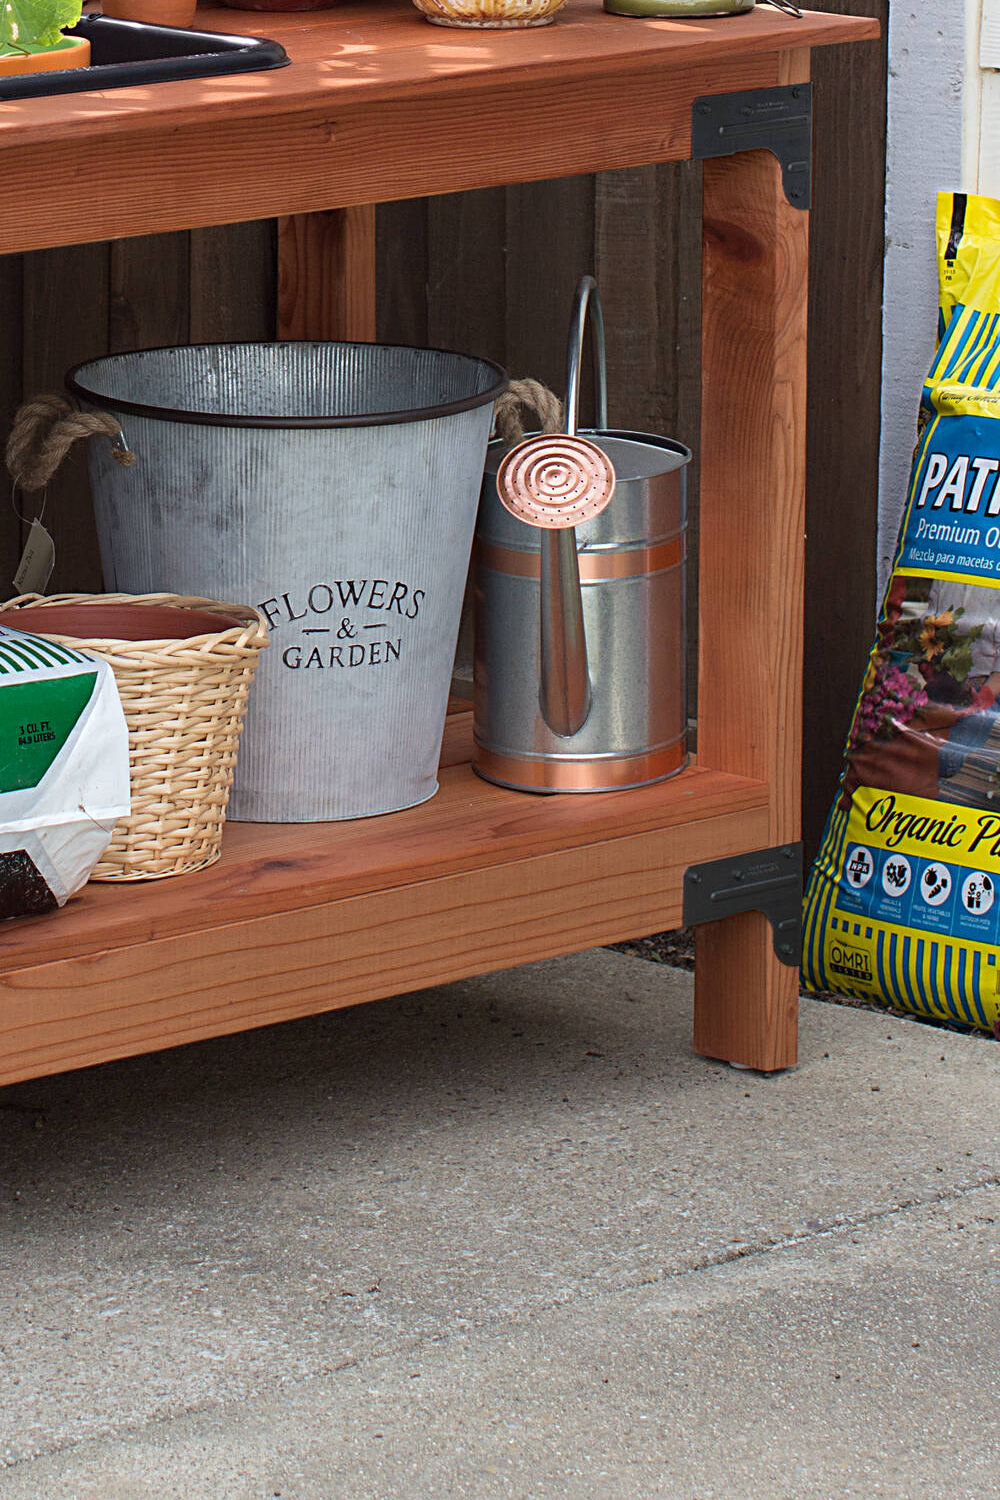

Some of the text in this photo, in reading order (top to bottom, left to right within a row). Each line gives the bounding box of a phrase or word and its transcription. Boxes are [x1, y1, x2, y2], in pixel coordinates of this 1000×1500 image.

[915, 518, 981, 546] Premium
[908, 547, 935, 562] Mezcla
[936, 552, 955, 567] para
[957, 555, 994, 571] macetas
[257, 580, 426, 631] FLOWERS
[336, 617, 358, 639] &
[282, 639, 402, 669] GARDEN
[33, 731, 56, 745] LITERS
[865, 795, 967, 847] Organic
[851, 861, 869, 873] NPK
[831, 946, 869, 972] OMRI
